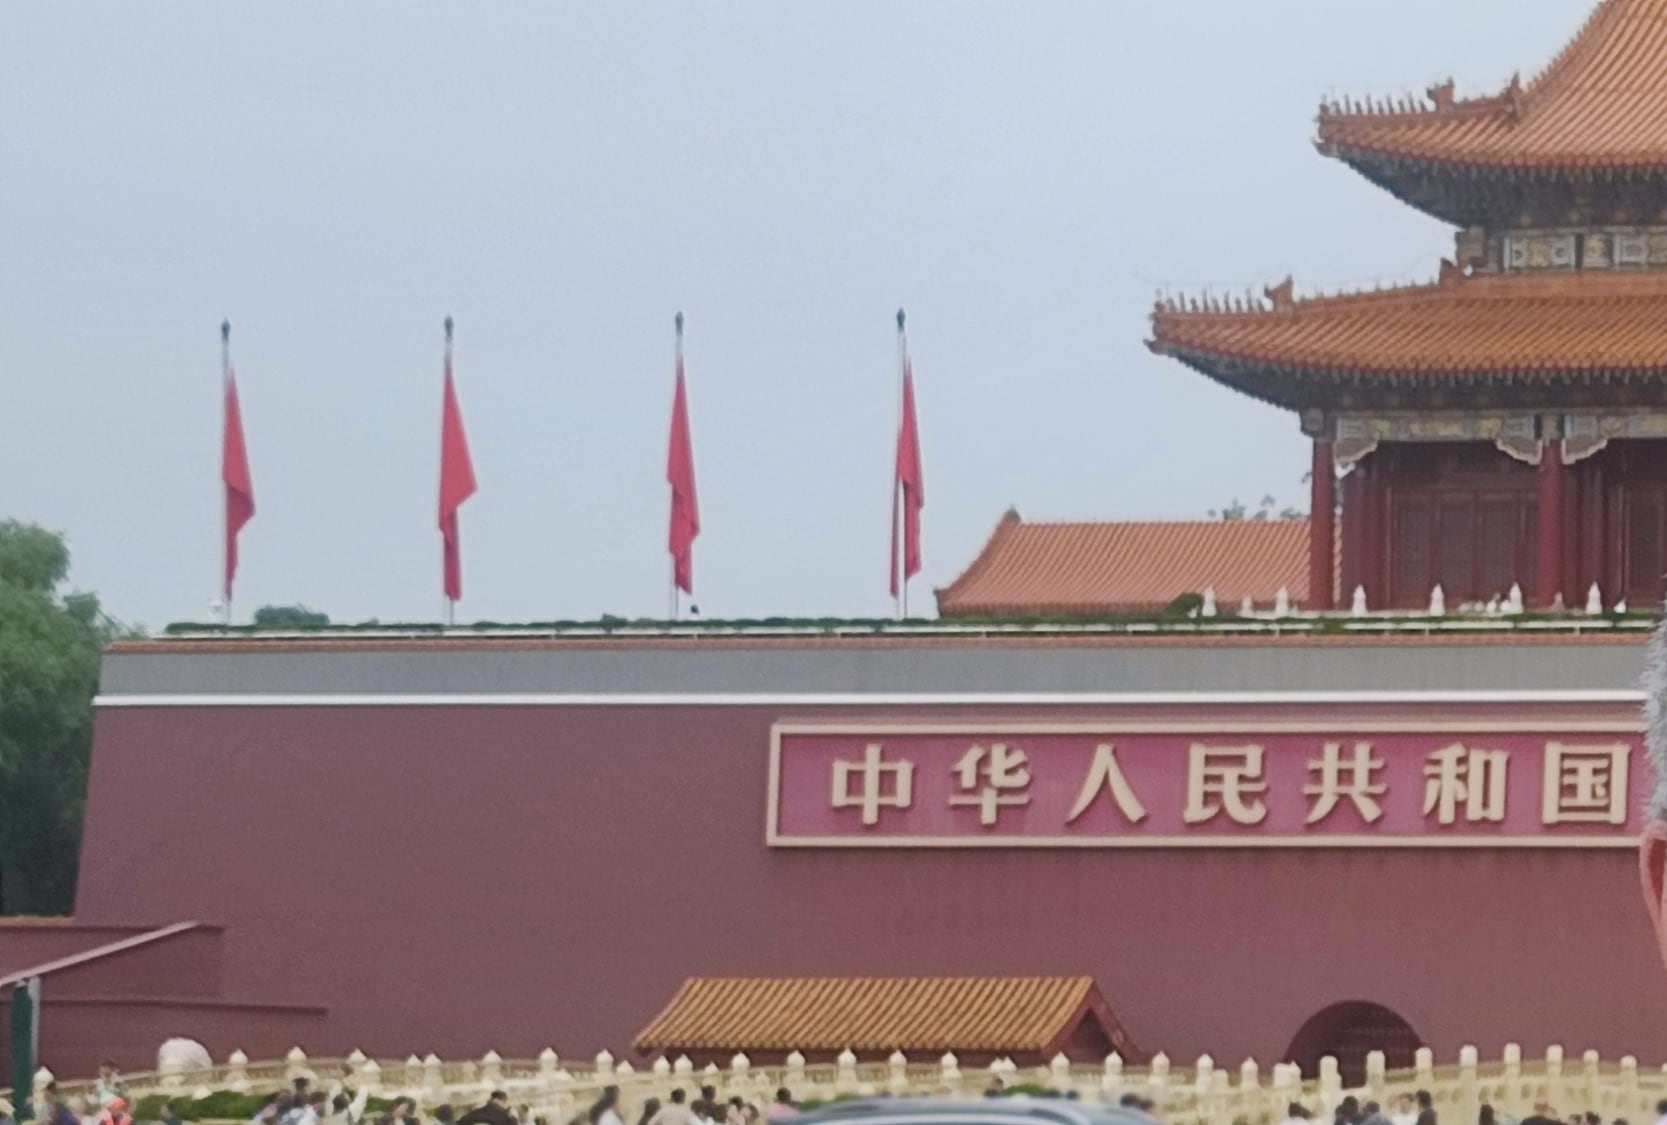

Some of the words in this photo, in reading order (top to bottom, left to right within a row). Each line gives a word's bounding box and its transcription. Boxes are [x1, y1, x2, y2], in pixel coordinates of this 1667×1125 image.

[832, 741, 1631, 824] 中华人民共和国
